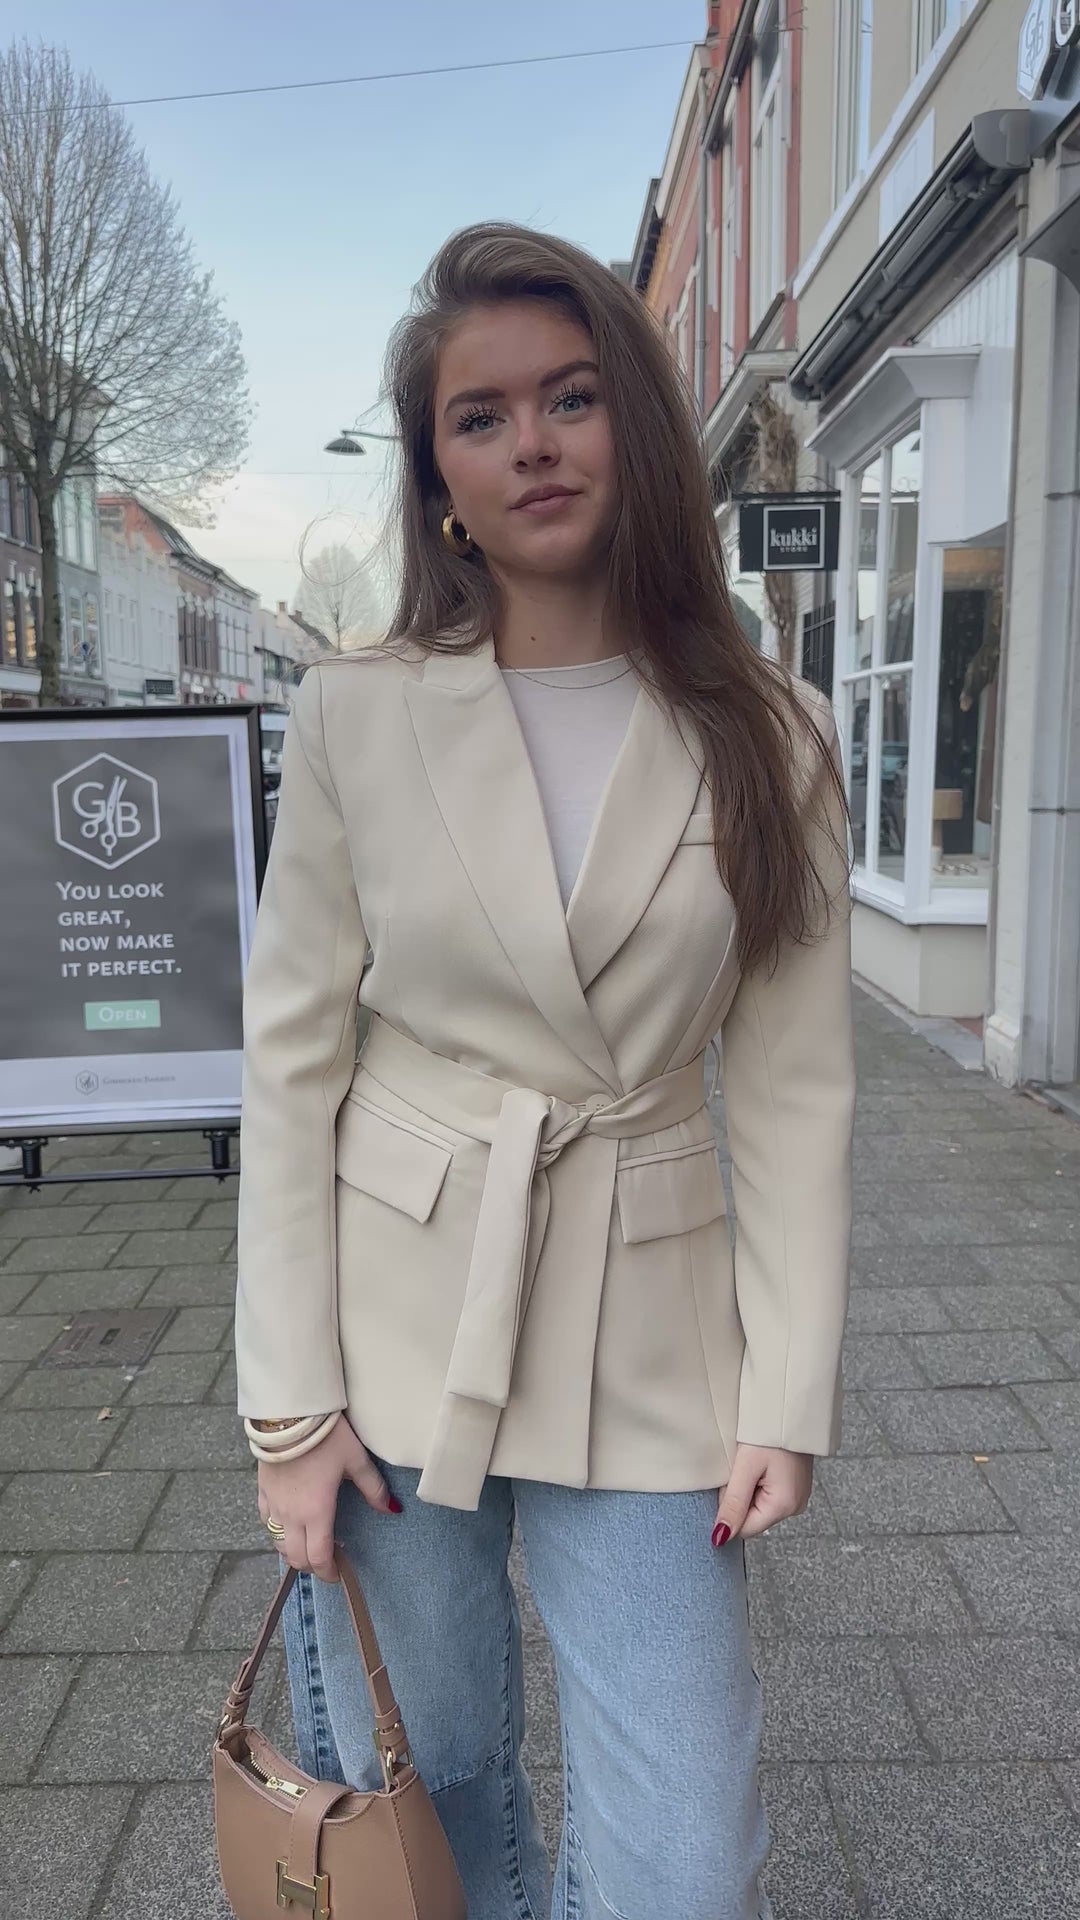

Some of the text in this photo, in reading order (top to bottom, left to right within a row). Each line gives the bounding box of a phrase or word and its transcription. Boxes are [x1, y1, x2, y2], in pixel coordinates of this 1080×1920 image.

[770, 527, 817, 546] kukki
[58, 909, 131, 929] GREAT,
[60, 933, 175, 951] NOW MAKE
[61, 959, 183, 977] IT PERFECT.
